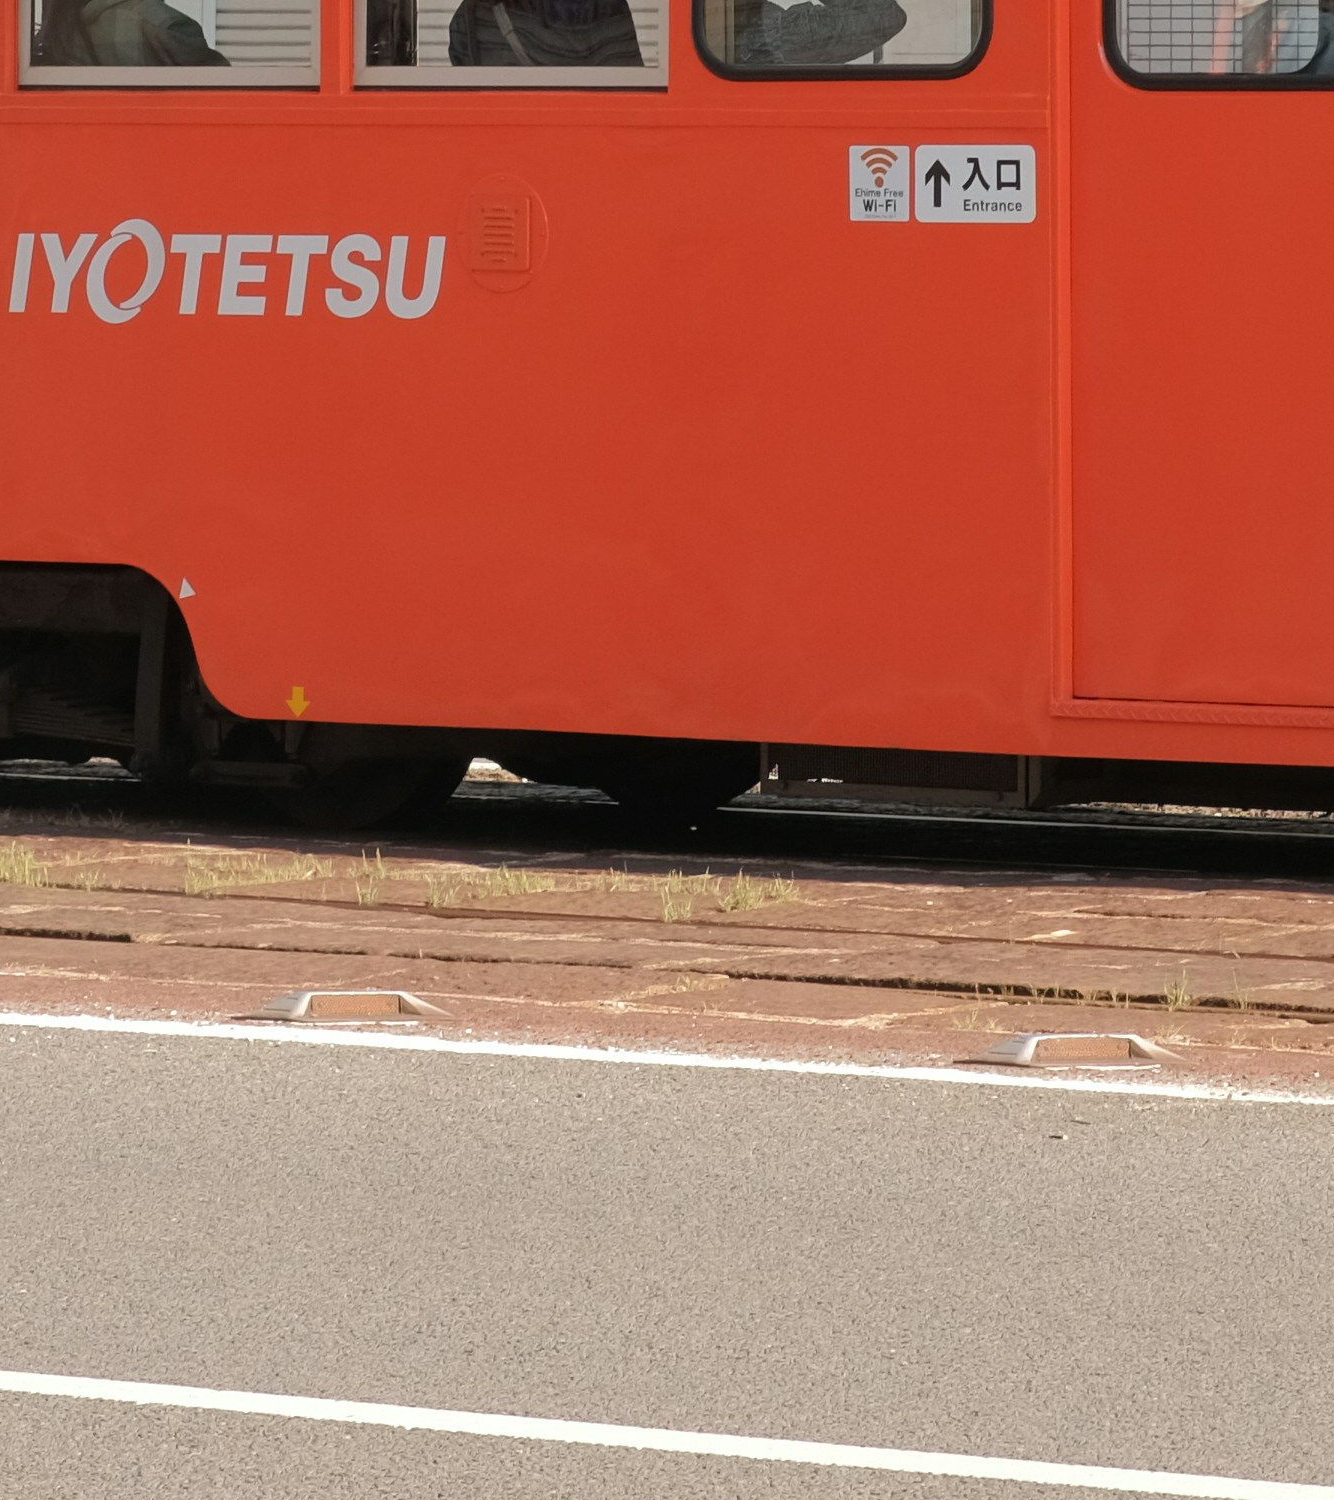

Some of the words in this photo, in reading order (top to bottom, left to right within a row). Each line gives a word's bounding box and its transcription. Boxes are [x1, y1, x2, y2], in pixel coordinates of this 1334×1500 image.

[962, 157, 1021, 191] 入口
[855, 188, 881, 198] Ehime
[884, 188, 904, 197] Free
[963, 199, 1022, 212] Entrance
[8, 218, 446, 324] IYOTETSU
